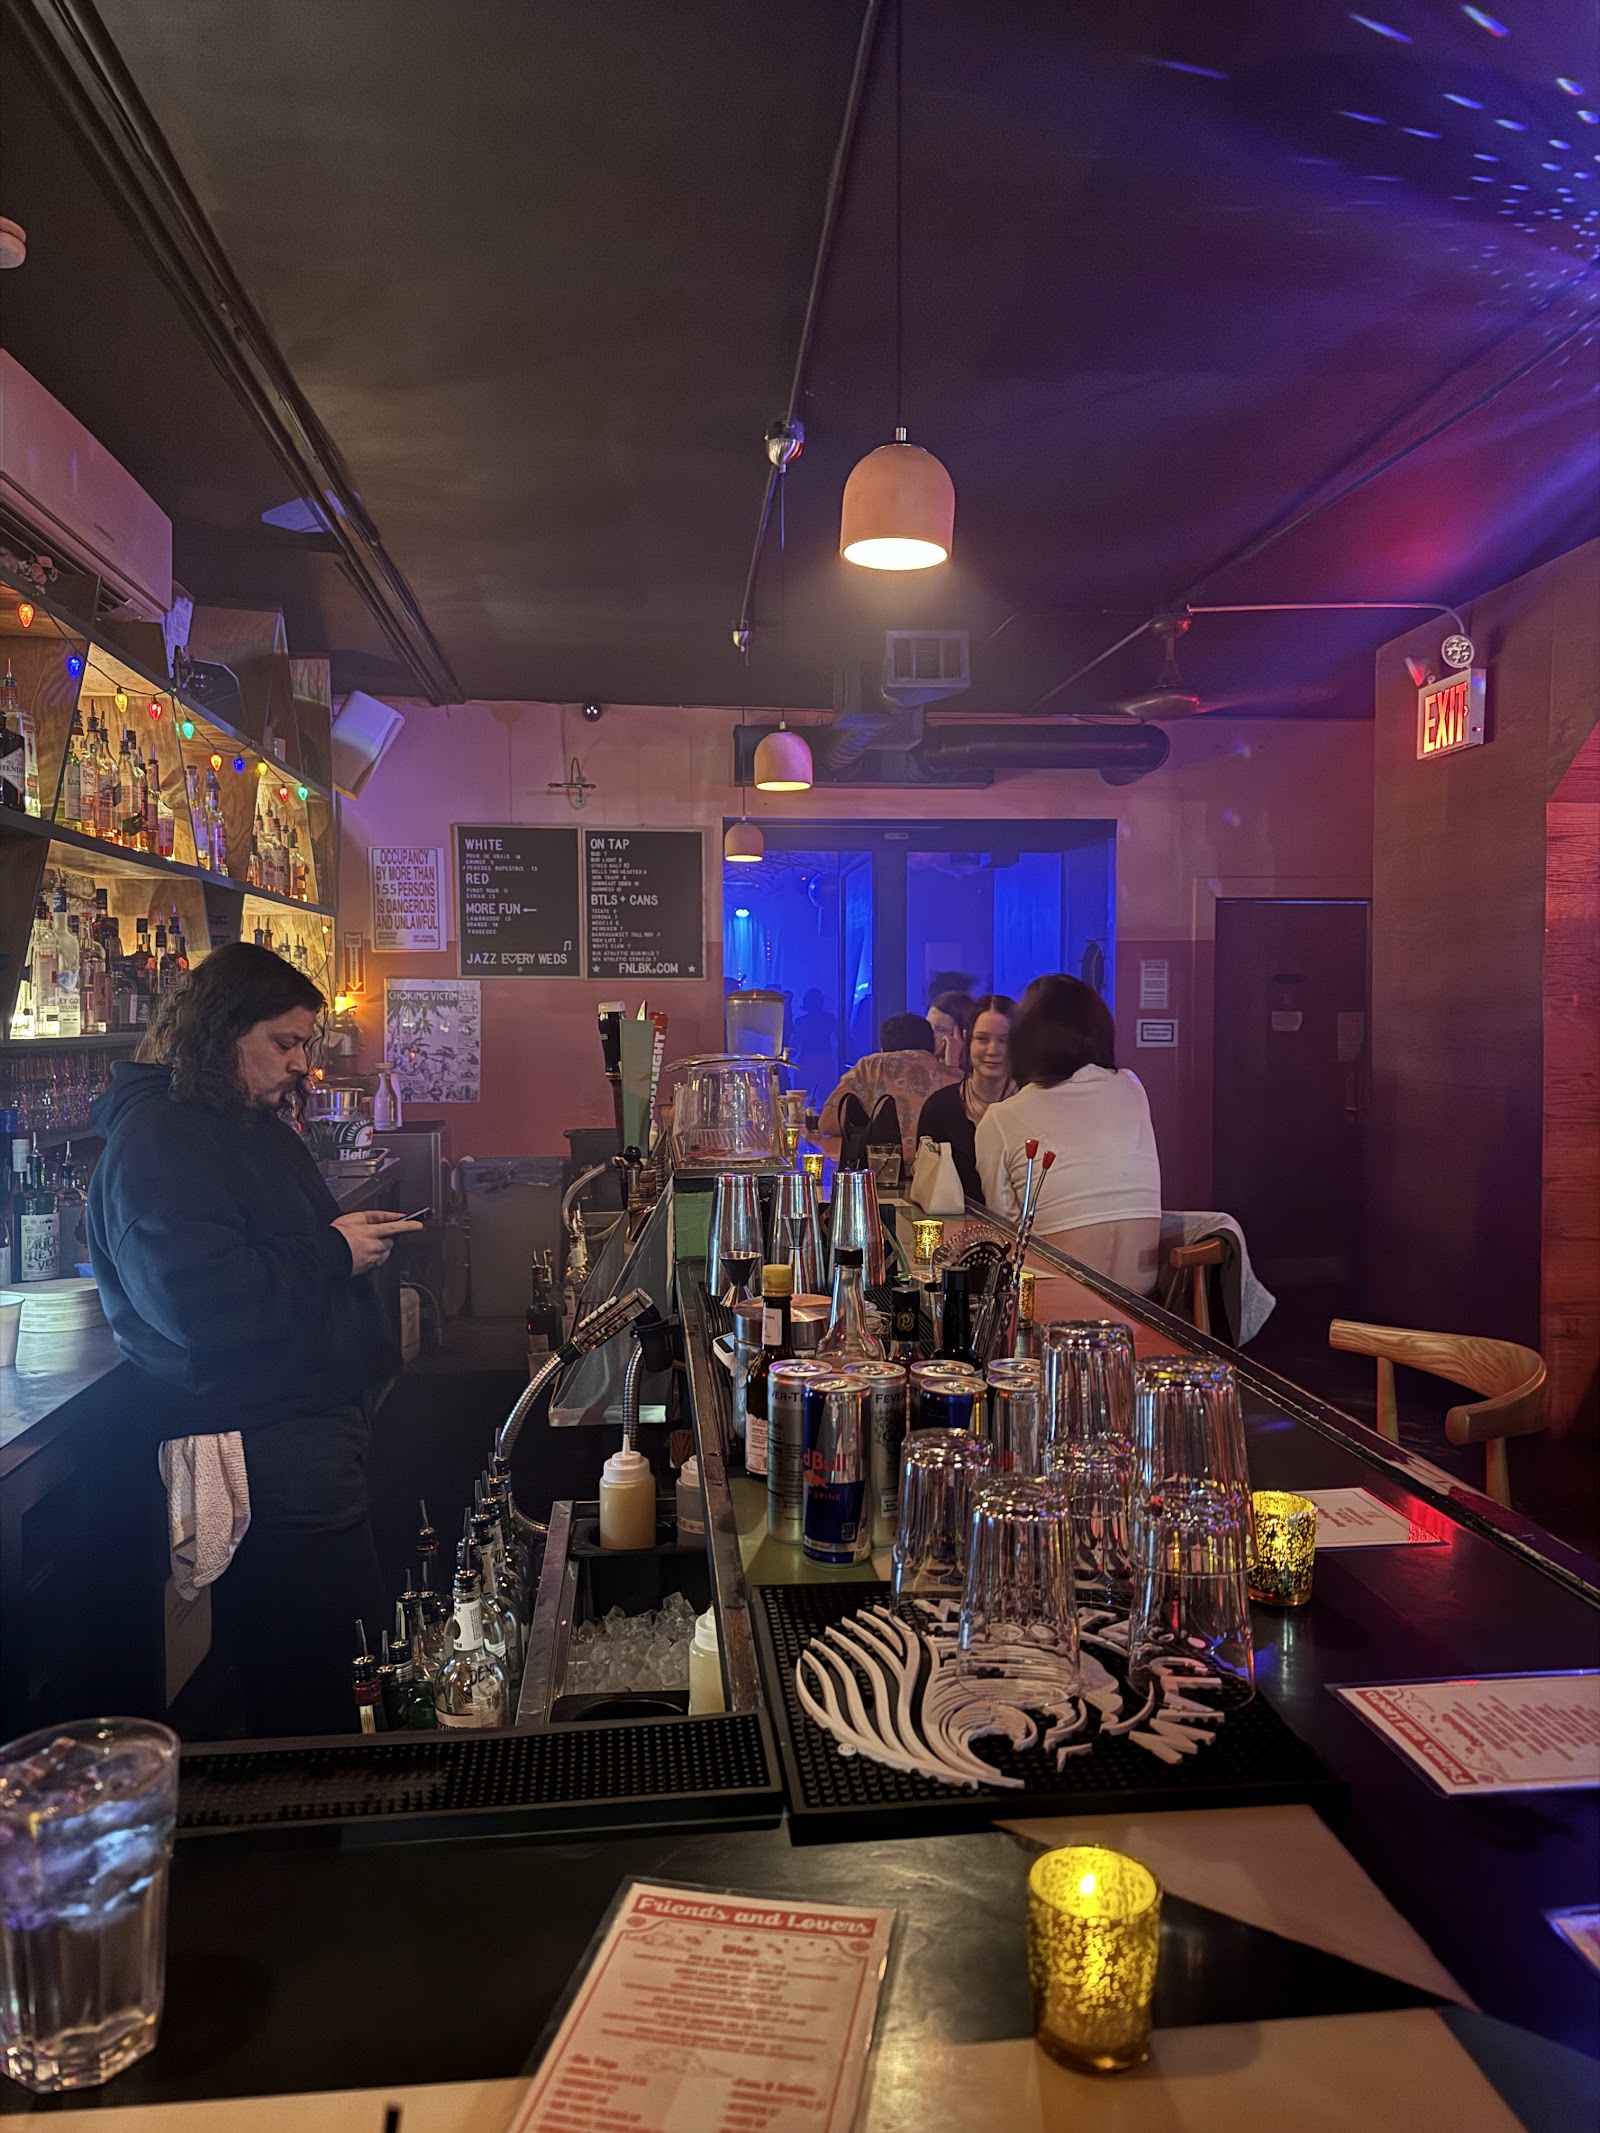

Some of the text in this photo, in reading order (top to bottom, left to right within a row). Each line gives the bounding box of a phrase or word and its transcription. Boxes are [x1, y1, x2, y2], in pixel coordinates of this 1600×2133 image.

[1423, 682, 1468, 753] EXIT
[464, 839, 503, 850] WHITE
[590, 839, 630, 850] ON TAP
[380, 848, 429, 864] OCCUPANCY
[375, 866, 435, 880] BY MORE THAN
[465, 873, 489, 884] RED
[375, 882, 435, 897] 155 PERSONS
[377, 899, 436, 913] IS DANGEROUS
[590, 894, 618, 905] BTLS
[629, 895, 659, 905] CANS
[465, 903, 521, 914] MORE FUN
[376, 915, 438, 930] AND UNLAWFUL
[467, 953, 497, 964] JAZZ
[538, 953, 568, 964] WEDS
[619, 962, 679, 974] FNLBK.COM
[388, 991, 458, 1001] CHOKING VICTIM
[651, 1031, 666, 1082] LIGHT
[812, 1451, 847, 1472] Bull
[637, 1897, 871, 1934] Friends and Lovers
